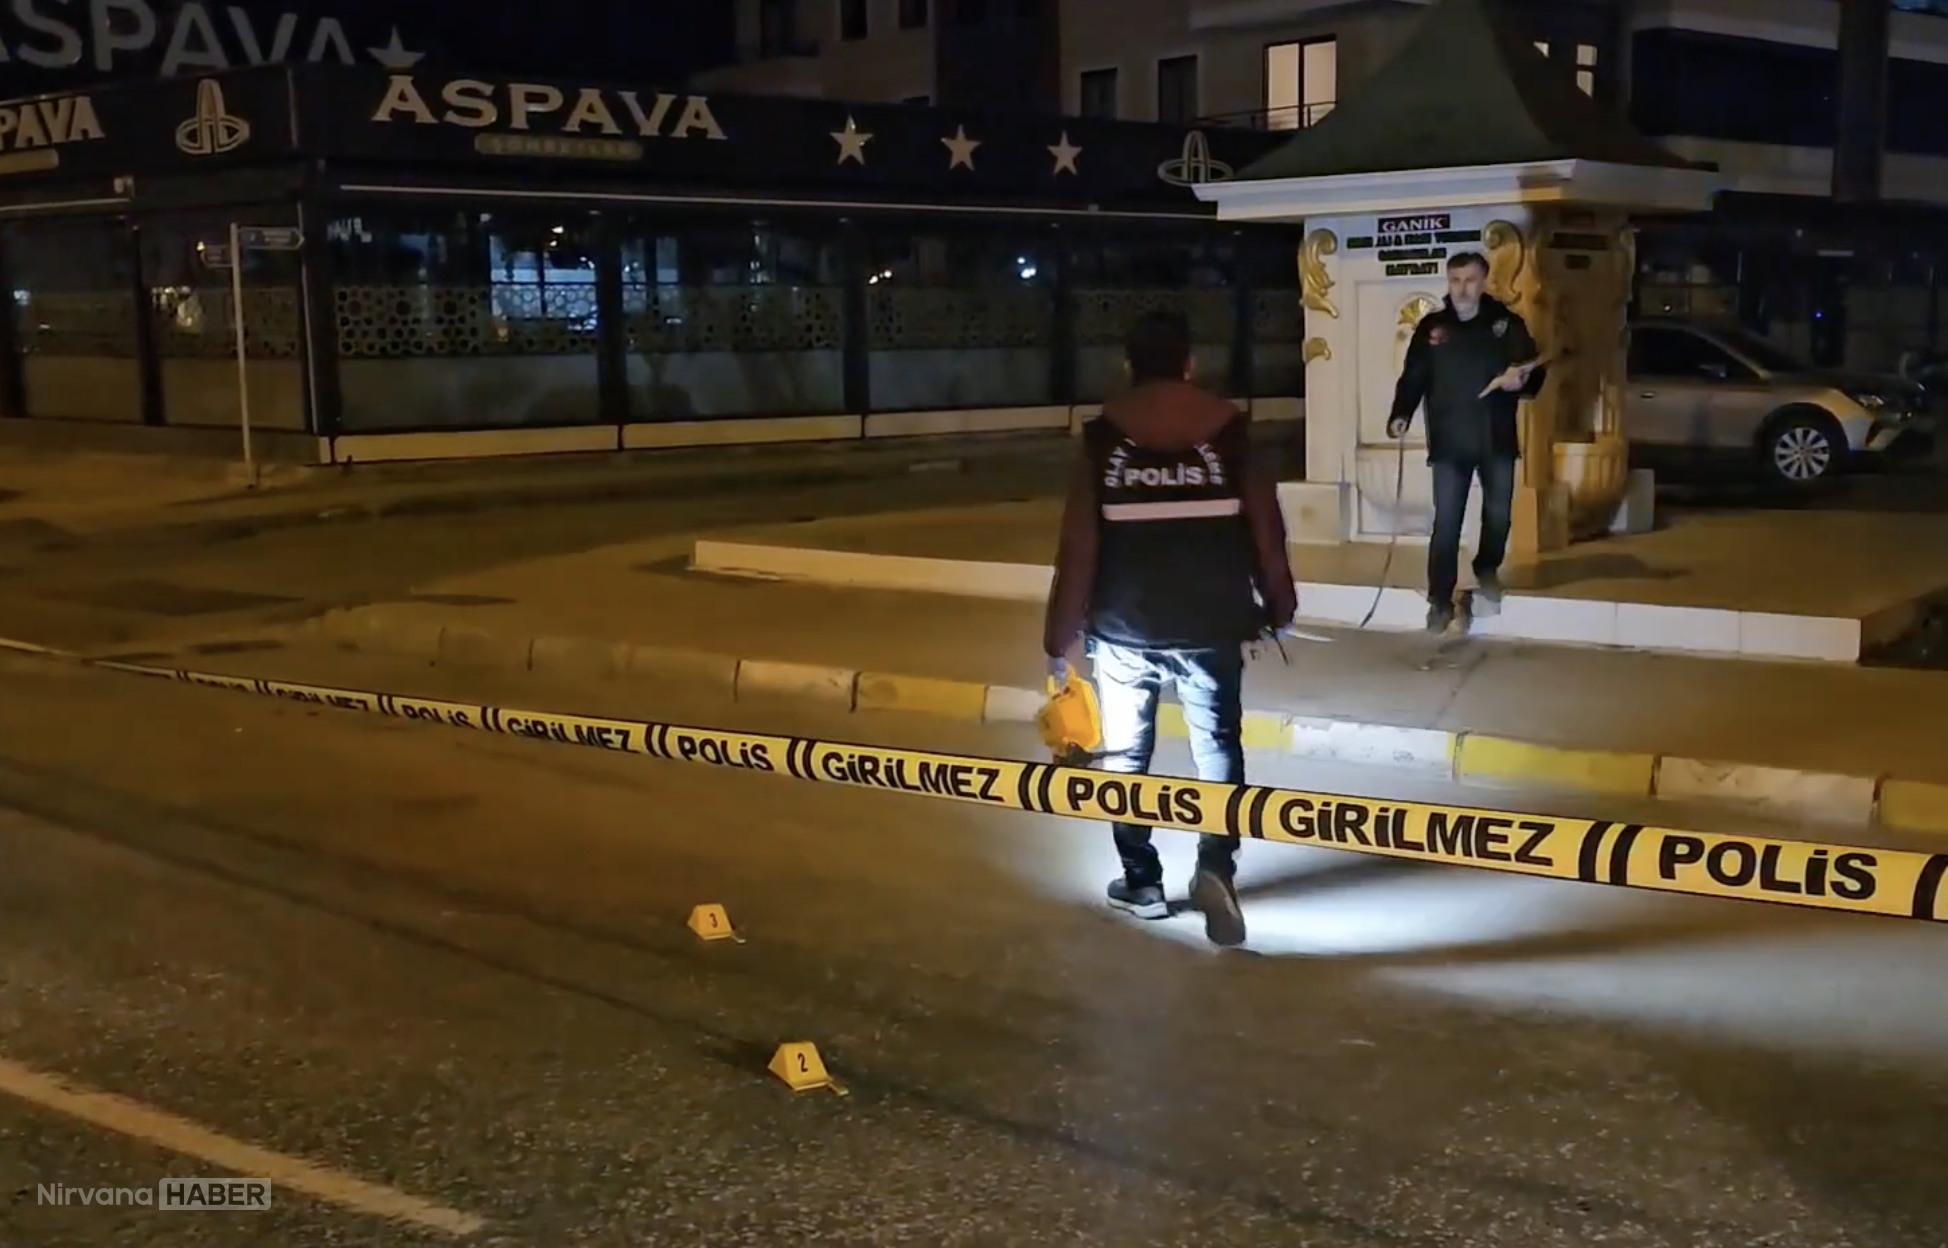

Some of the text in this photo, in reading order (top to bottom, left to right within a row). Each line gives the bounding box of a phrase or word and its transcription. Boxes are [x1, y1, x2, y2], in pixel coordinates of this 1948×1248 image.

[0, 0, 356, 77] SPAVA
[370, 73, 729, 141] ASPAVA
[708, 912, 719, 929] 3
[797, 1052, 809, 1073] 2
